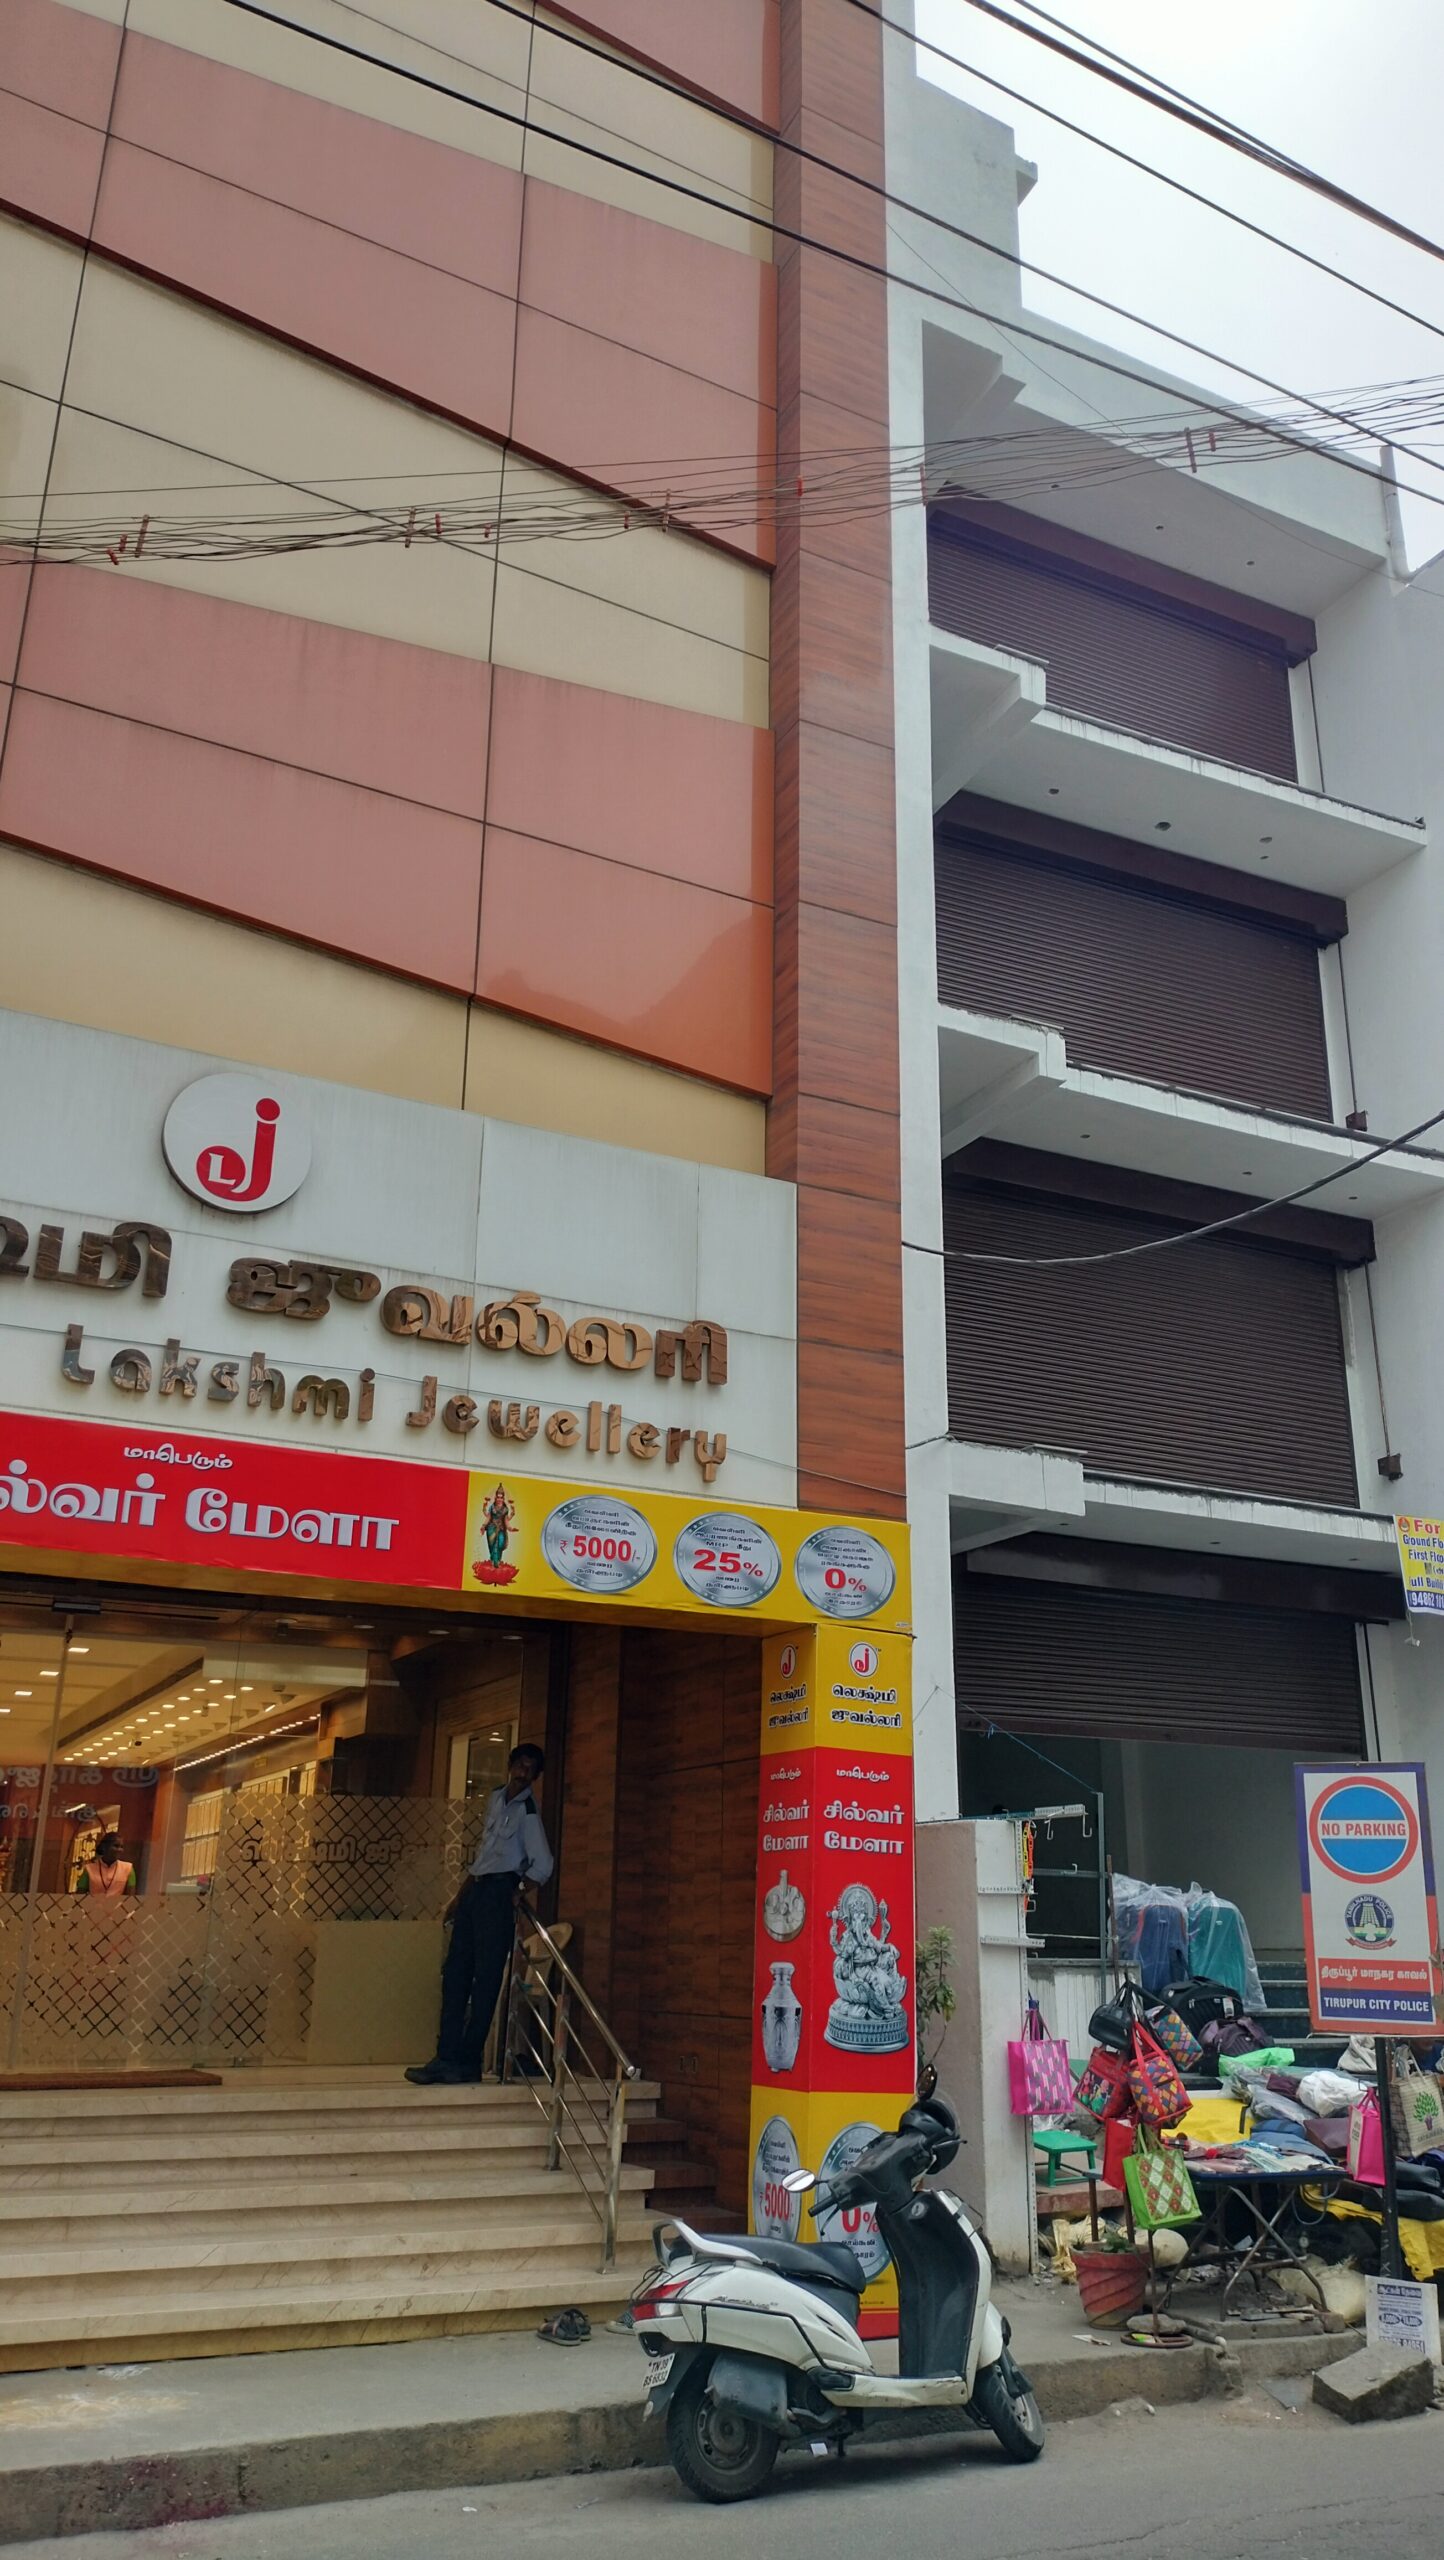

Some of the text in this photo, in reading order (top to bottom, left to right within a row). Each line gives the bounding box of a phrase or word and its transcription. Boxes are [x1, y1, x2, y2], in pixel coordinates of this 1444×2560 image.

[61, 1323, 728, 1483] Lakshmi Jewellery
[123, 1442, 233, 1471] மாபெரும்
[184, 1487, 400, 1551] மேளா
[1413, 1519, 1441, 1534] For
[1402, 1534, 1431, 1547] Ground
[692, 1548, 764, 1578] 25%
[1408, 1549, 1428, 1561] First
[824, 1567, 868, 1593] 0%
[836, 1765, 890, 1783] மாபெரும்
[763, 1798, 810, 1824] சில்வர்
[823, 1799, 905, 1825] சில்வர்
[1321, 1822, 1407, 1837] NO PARKING
[762, 1833, 809, 1852] மேளா
[823, 1830, 905, 1854] மேளா
[1375, 1896, 1393, 1920] POLICE
[1324, 1996, 1430, 2012] TIRUPUR CITY POLICE
